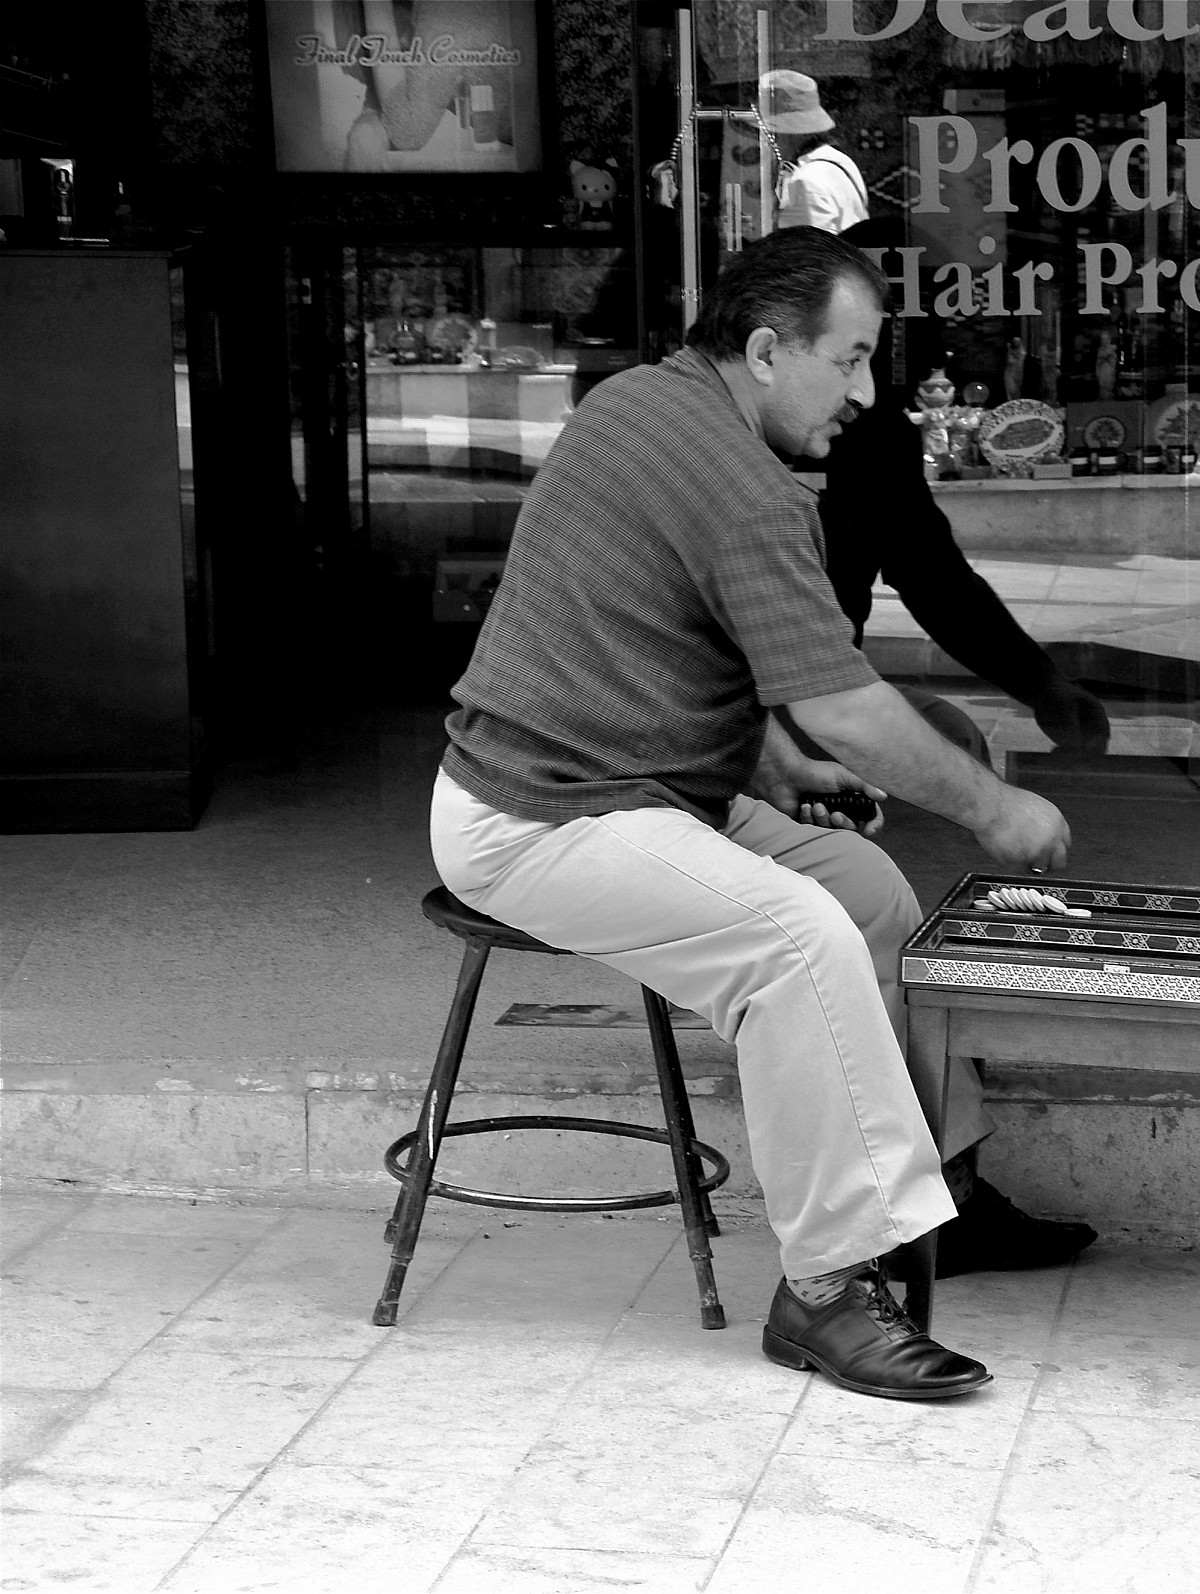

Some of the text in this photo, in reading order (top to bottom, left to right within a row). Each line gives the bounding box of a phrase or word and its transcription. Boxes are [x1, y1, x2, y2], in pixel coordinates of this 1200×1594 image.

[296, 34, 521, 67] Final Touch Cosmetics
[858, 235, 1055, 318] Hair
